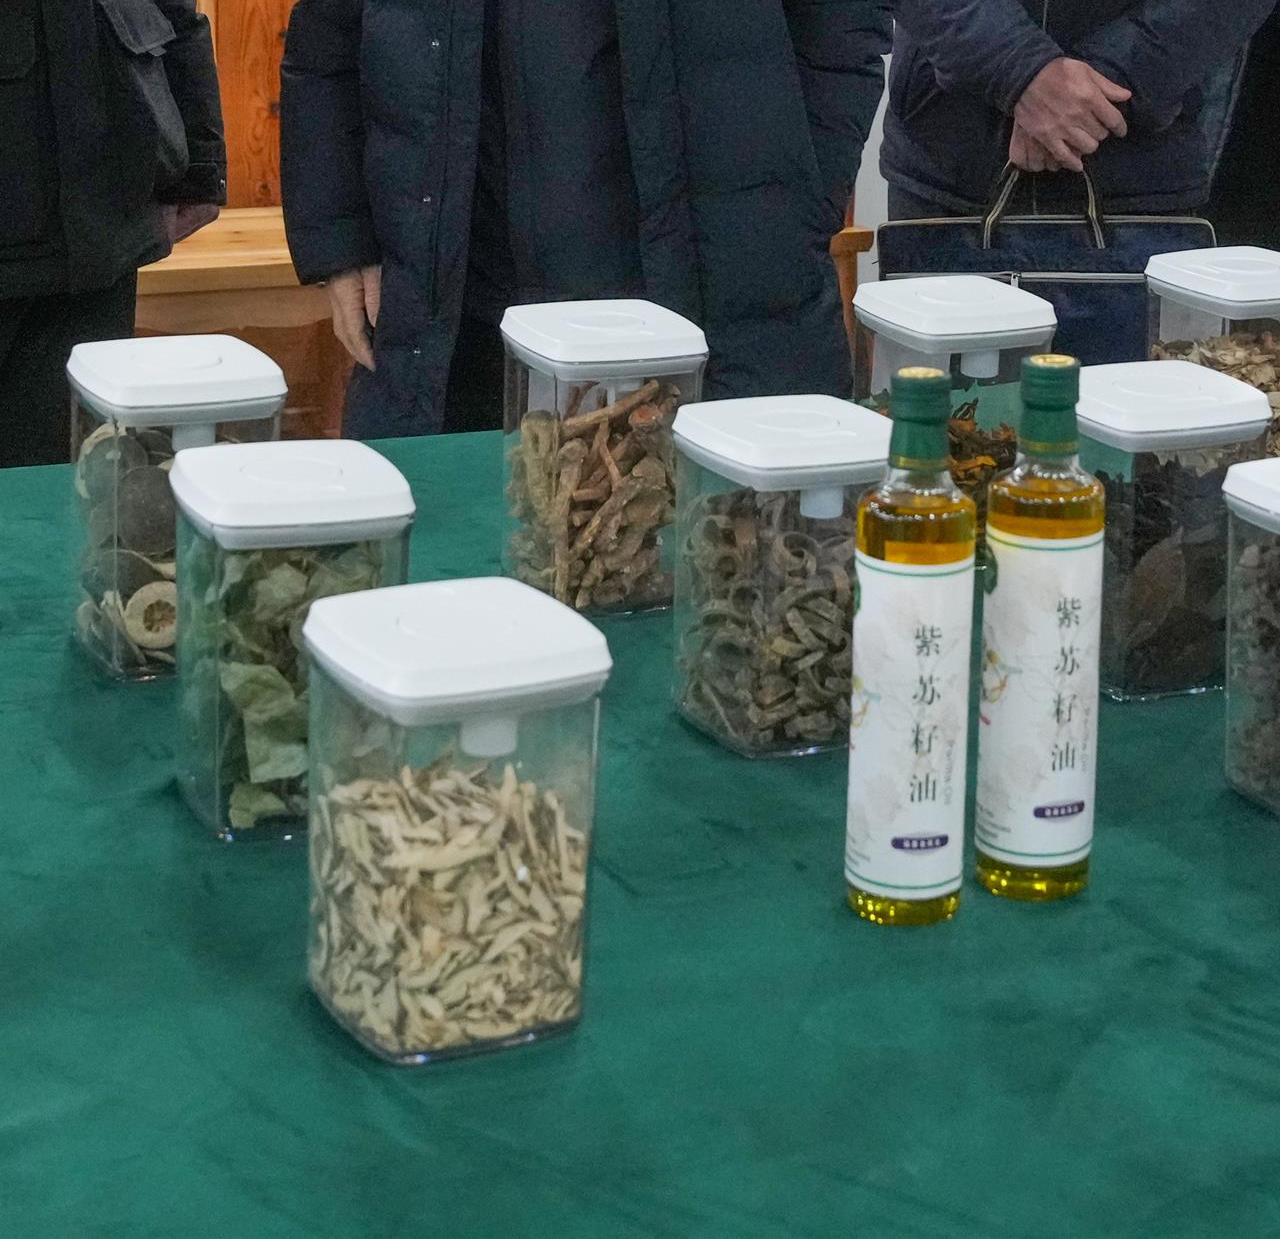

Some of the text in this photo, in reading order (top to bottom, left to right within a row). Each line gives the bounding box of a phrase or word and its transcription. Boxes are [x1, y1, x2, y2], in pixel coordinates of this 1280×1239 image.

[907, 625, 943, 804] 紫苏籽油
[1050, 596, 1083, 773] 紫苏籽油
